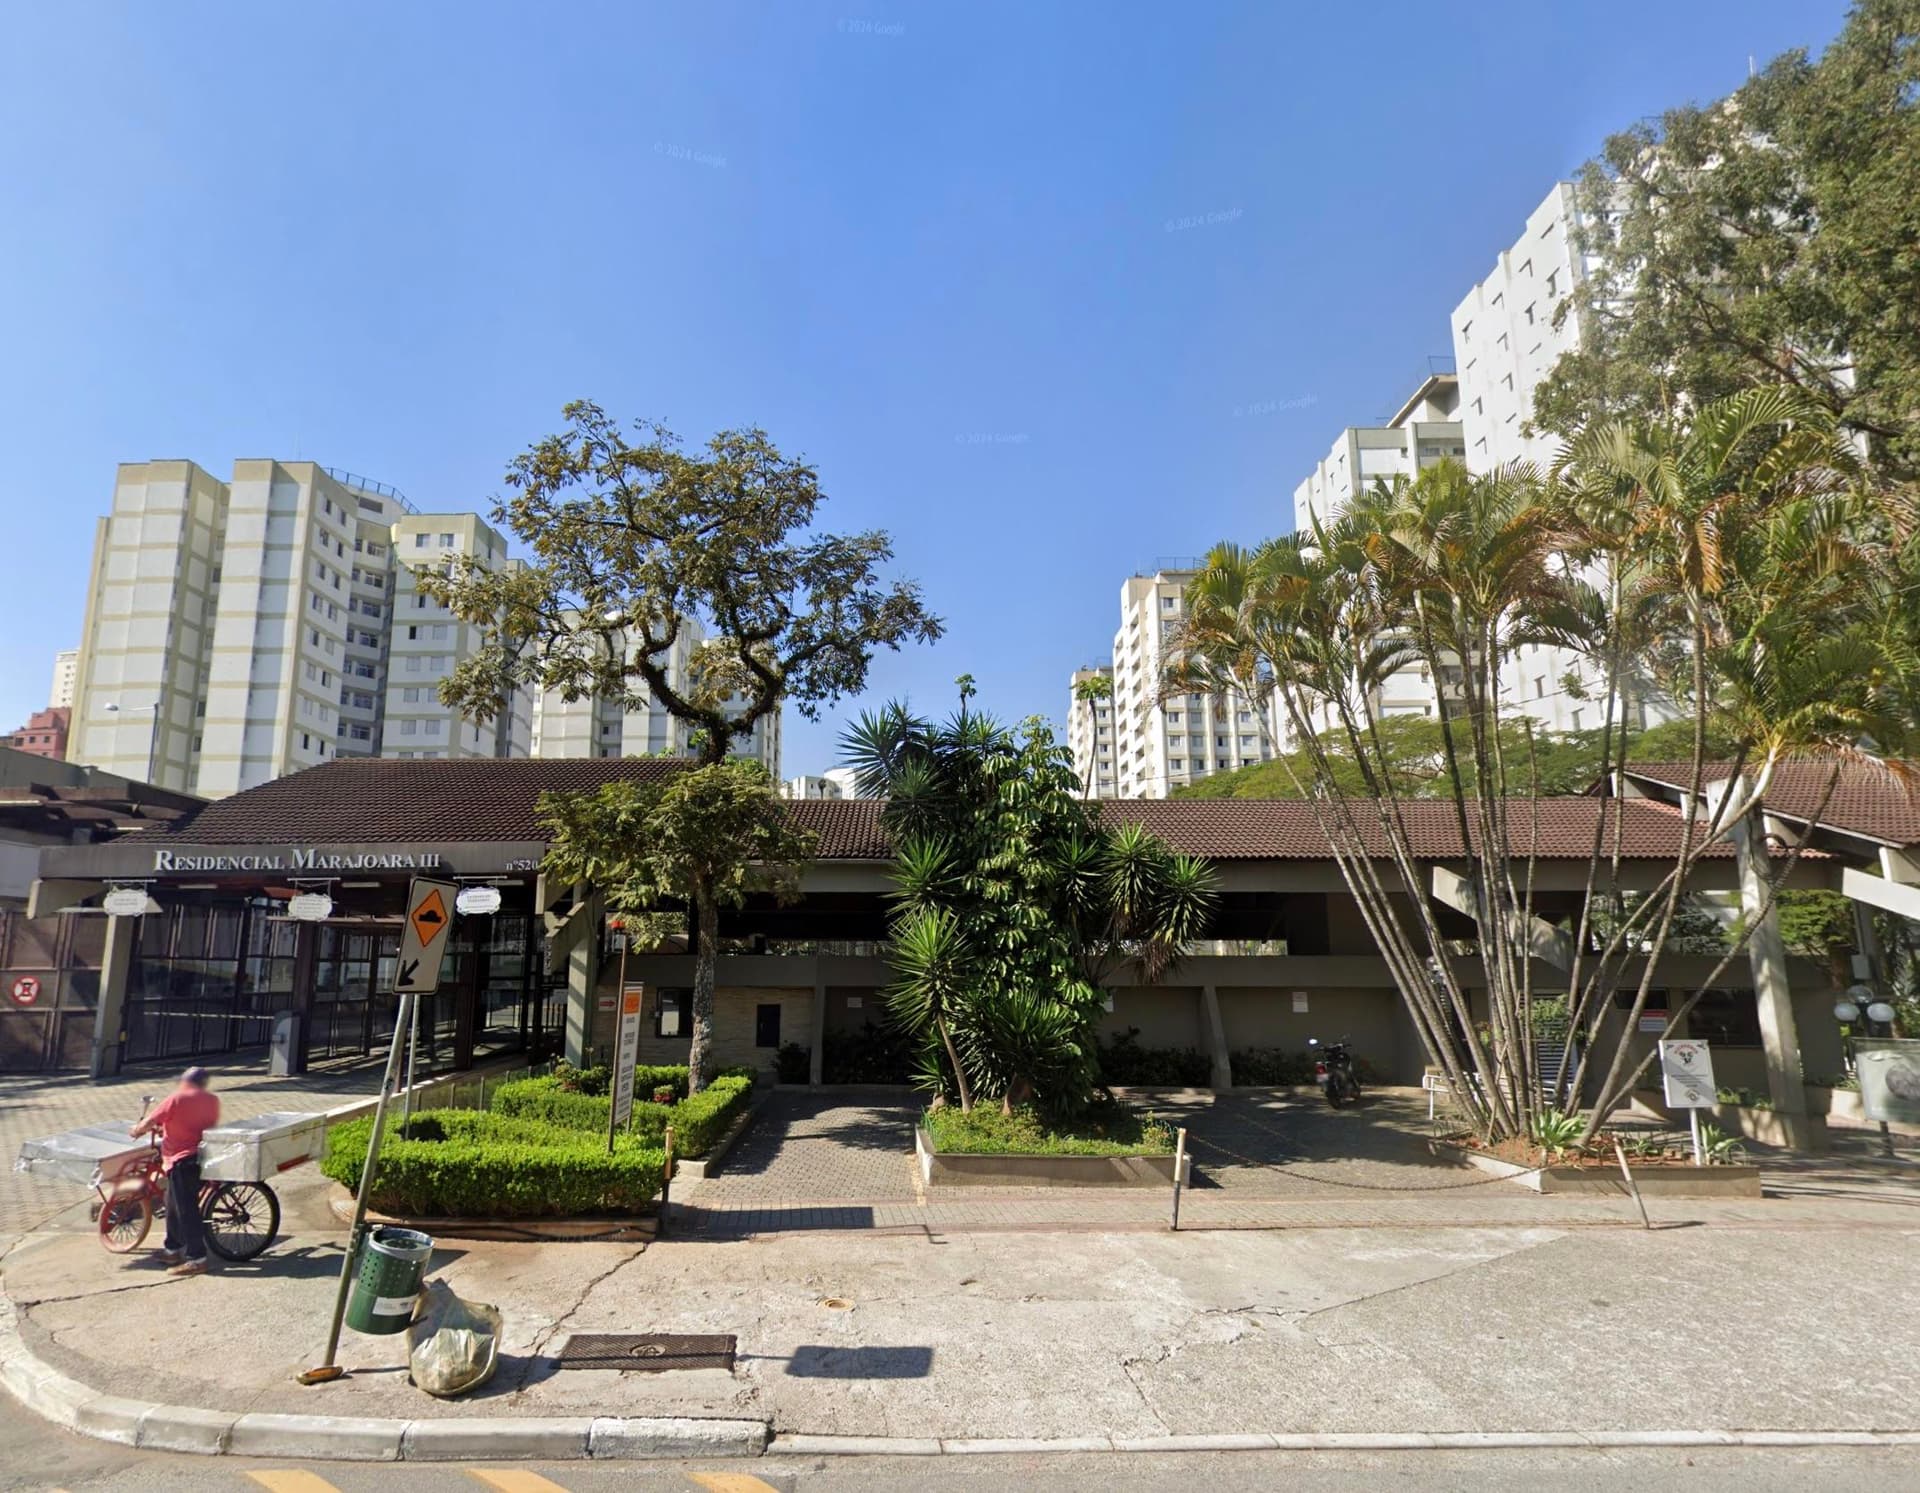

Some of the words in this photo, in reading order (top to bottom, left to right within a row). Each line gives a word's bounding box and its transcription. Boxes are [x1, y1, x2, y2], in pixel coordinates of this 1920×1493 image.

[153, 850, 286, 872] RESIDENCIAL
[290, 848, 416, 870] MARAJOARA
[420, 853, 441, 868] III
